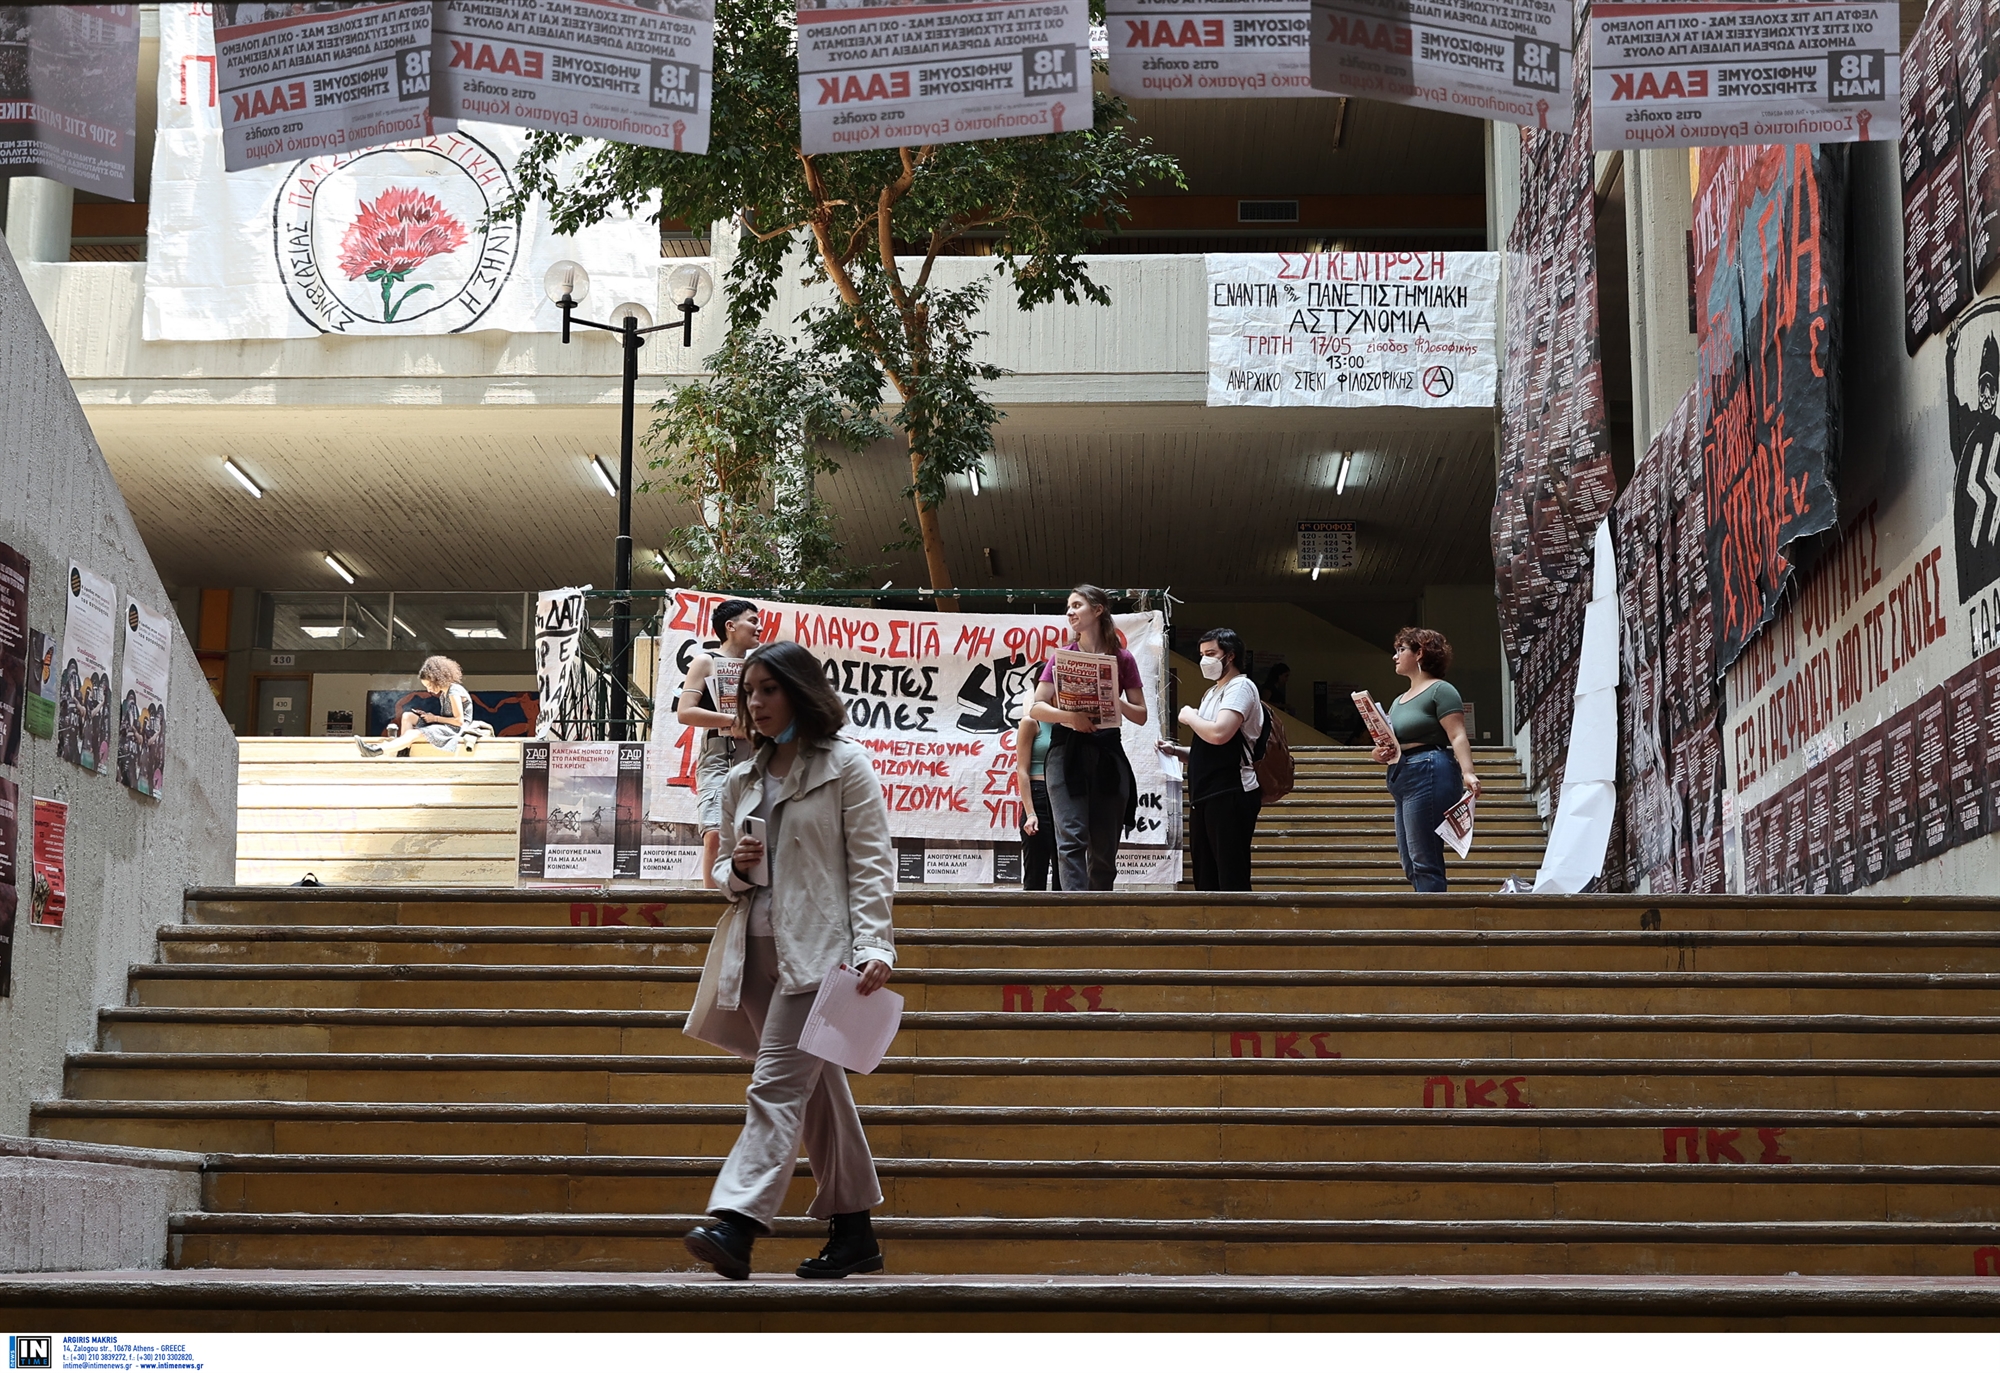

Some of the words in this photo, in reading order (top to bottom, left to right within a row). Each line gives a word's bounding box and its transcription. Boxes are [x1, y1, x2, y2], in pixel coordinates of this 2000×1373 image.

[1278, 252, 1444, 281] ΣΥΓΚΕΝΤΡΩΣΗ
[1214, 284, 1278, 307] ΕΝΑΝΤΙΑ
[1308, 283, 1467, 308] ΠΑΝΕΠΙΣΤΗΜΙΑΚΗ
[1289, 308, 1430, 334] ΑΣΤΥΝΟΜΙΑ
[1244, 335, 1292, 356] ΤΡΙΤΗ
[1310, 337, 1352, 356] 17/05
[1326, 356, 1364, 369] 13:00
[1226, 371, 1281, 391] ΑΝΑΡΧΙΚΟ
[1295, 372, 1326, 390] ΣΤΕΚΙ
[1337, 371, 1414, 392] ΦΙΛΟΣΟΦΙΚΗΣ
[1800, 503, 1882, 647] ΦΟΙΤΗΤΕΣ
[953, 625, 995, 660] ΜΗ
[1758, 703, 1768, 777] Η
[1770, 647, 1833, 766] ΑΣΦΑΛΕΙΑ
[1836, 623, 1862, 716] ΑΠΟ
[1864, 601, 1888, 694] ΤΙΣ
[1889, 545, 1947, 674] ΣΧΟΛΕΣ
[526, 749, 547, 760] ΣΑΦ
[620, 750, 641, 760] ΣΑΦ
[1002, 985, 1118, 1013] ΠΚΣ
[1230, 1031, 1341, 1058] ΠΚΣ
[1423, 1076, 1535, 1109] ΠΚΣ
[1663, 1127, 1792, 1164] ΠΚΣ
